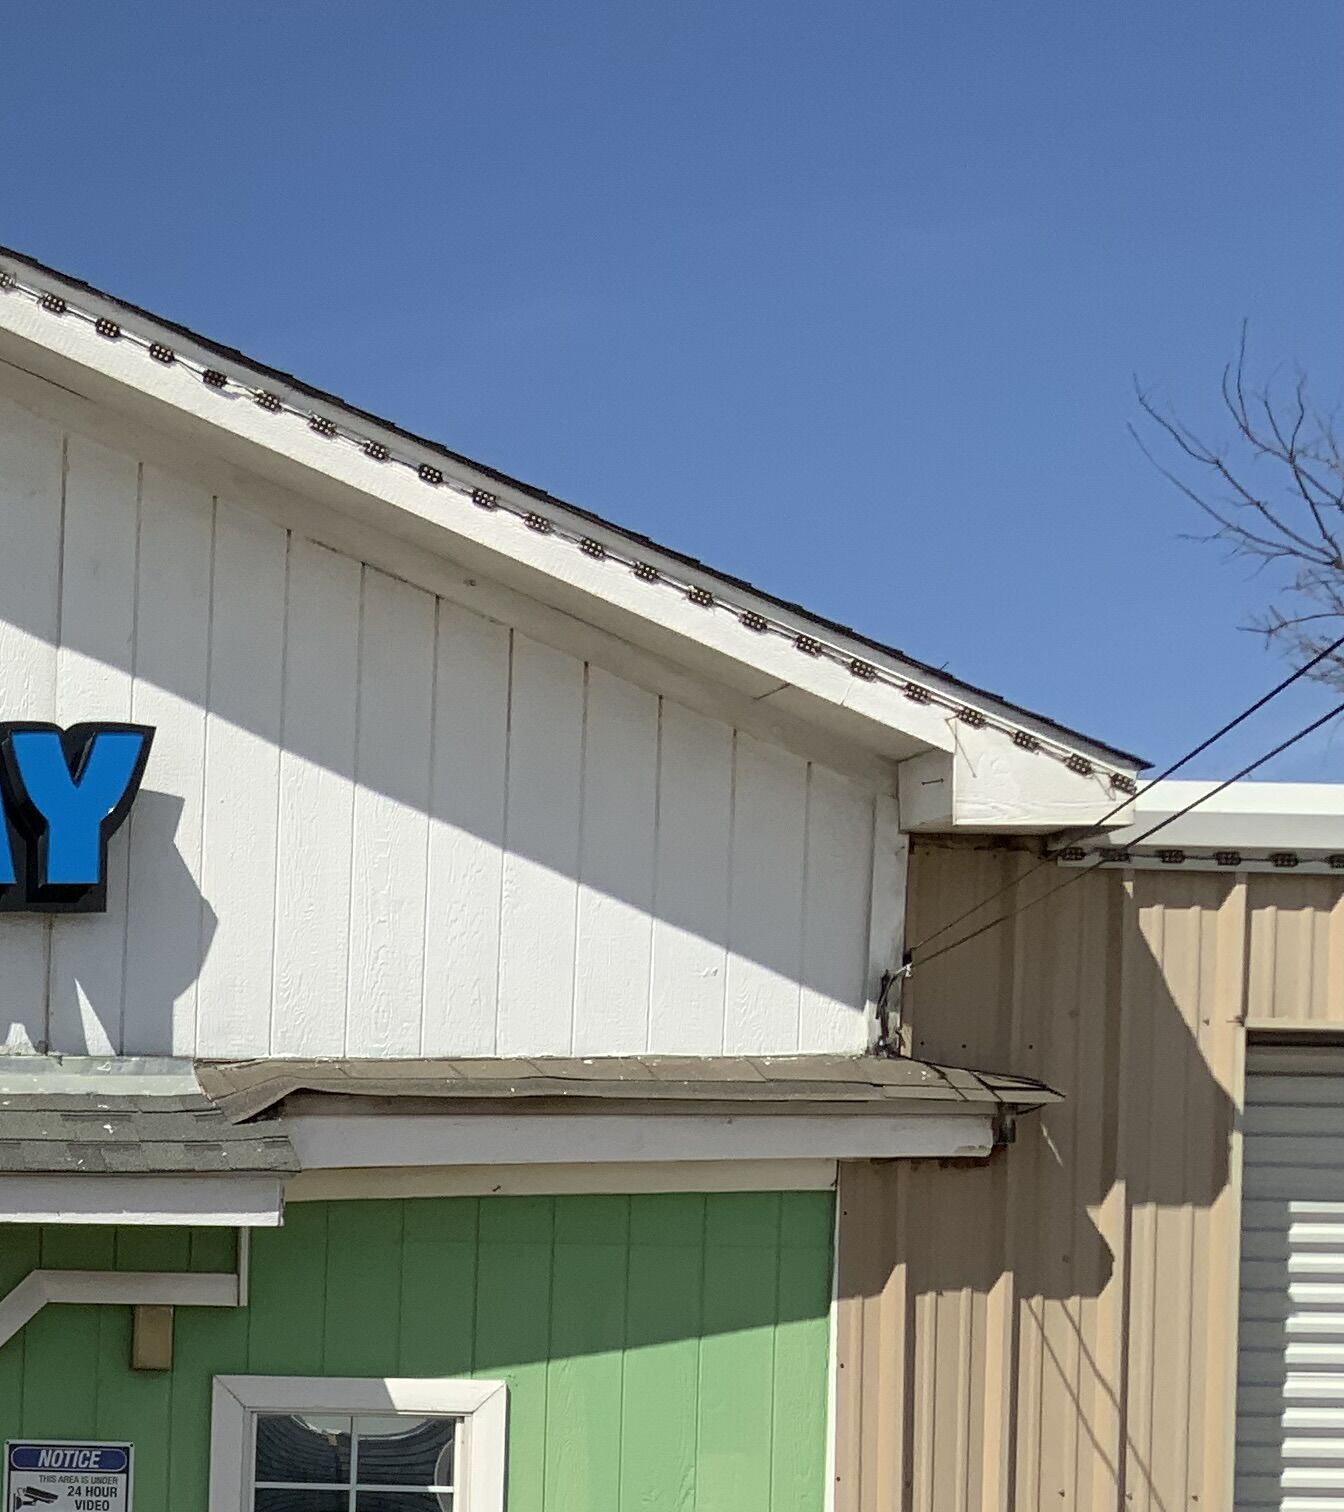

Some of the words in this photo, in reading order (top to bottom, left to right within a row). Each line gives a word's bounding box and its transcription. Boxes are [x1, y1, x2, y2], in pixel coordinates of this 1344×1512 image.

[38, 1449, 101, 1468] NOTICE
[39, 1475, 57, 1483] THIS
[58, 1475, 79, 1484] AREA
[81, 1476, 89, 1484] IS
[91, 1476, 118, 1485] UNDER
[67, 1485, 82, 1497] 24
[85, 1486, 117, 1498] HOUR
[74, 1499, 110, 1511] VIDEO
